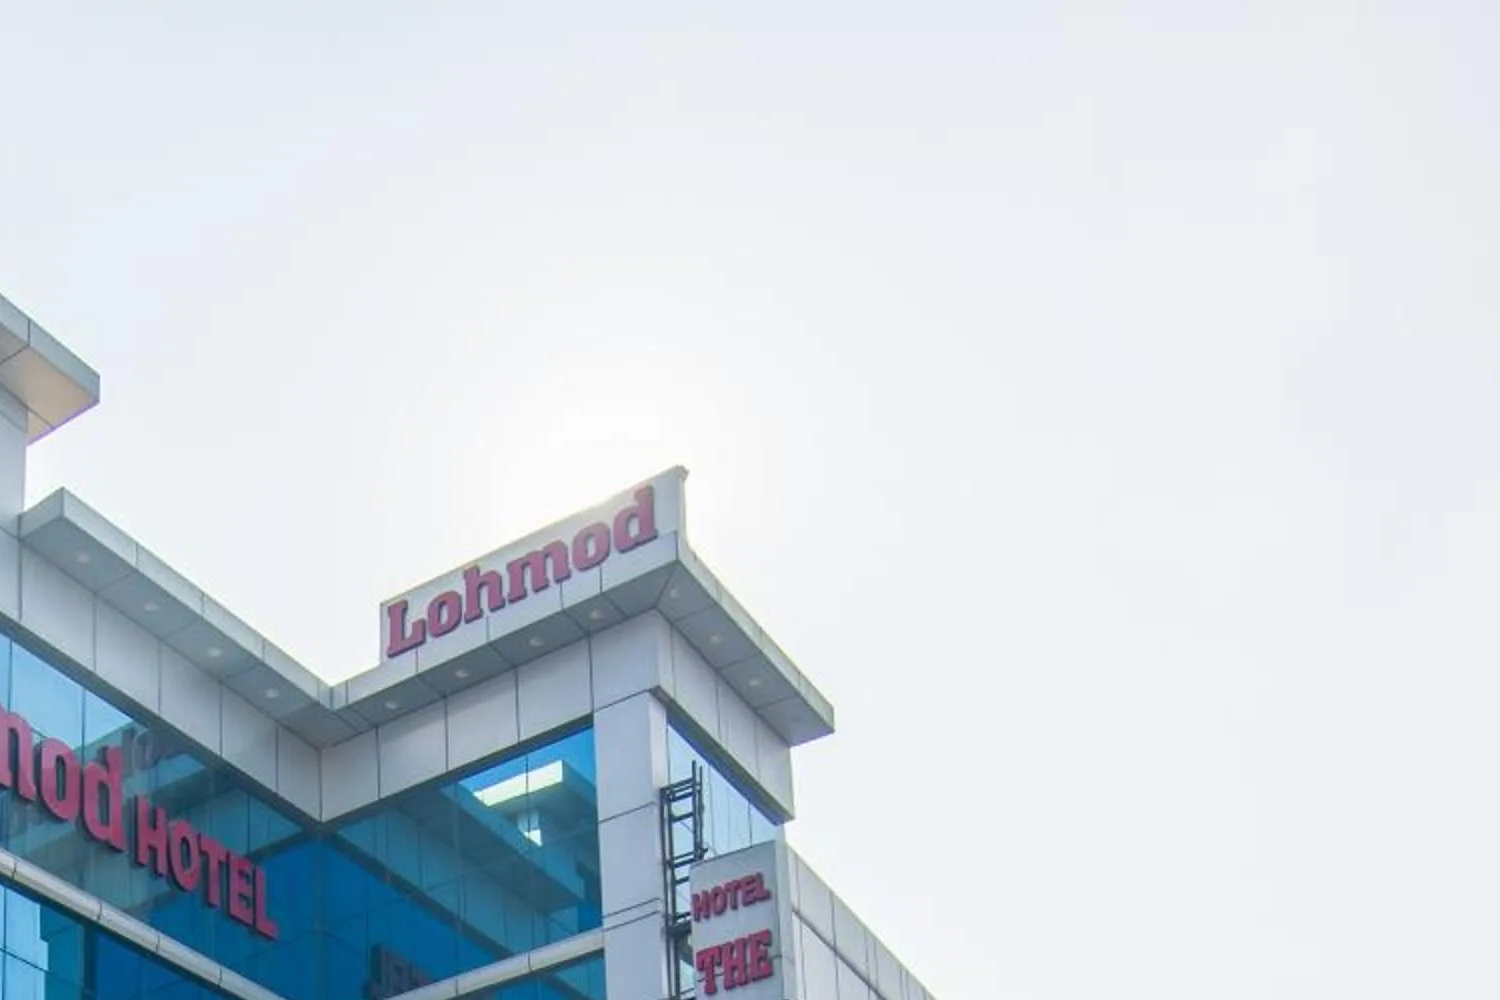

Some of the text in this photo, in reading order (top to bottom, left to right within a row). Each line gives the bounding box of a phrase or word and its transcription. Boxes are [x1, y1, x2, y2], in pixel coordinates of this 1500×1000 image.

[387, 484, 658, 658] Lohmod
[134, 796, 278, 940] HOTEL
[692, 872, 771, 922] HOTEL
[696, 928, 773, 996] THE
